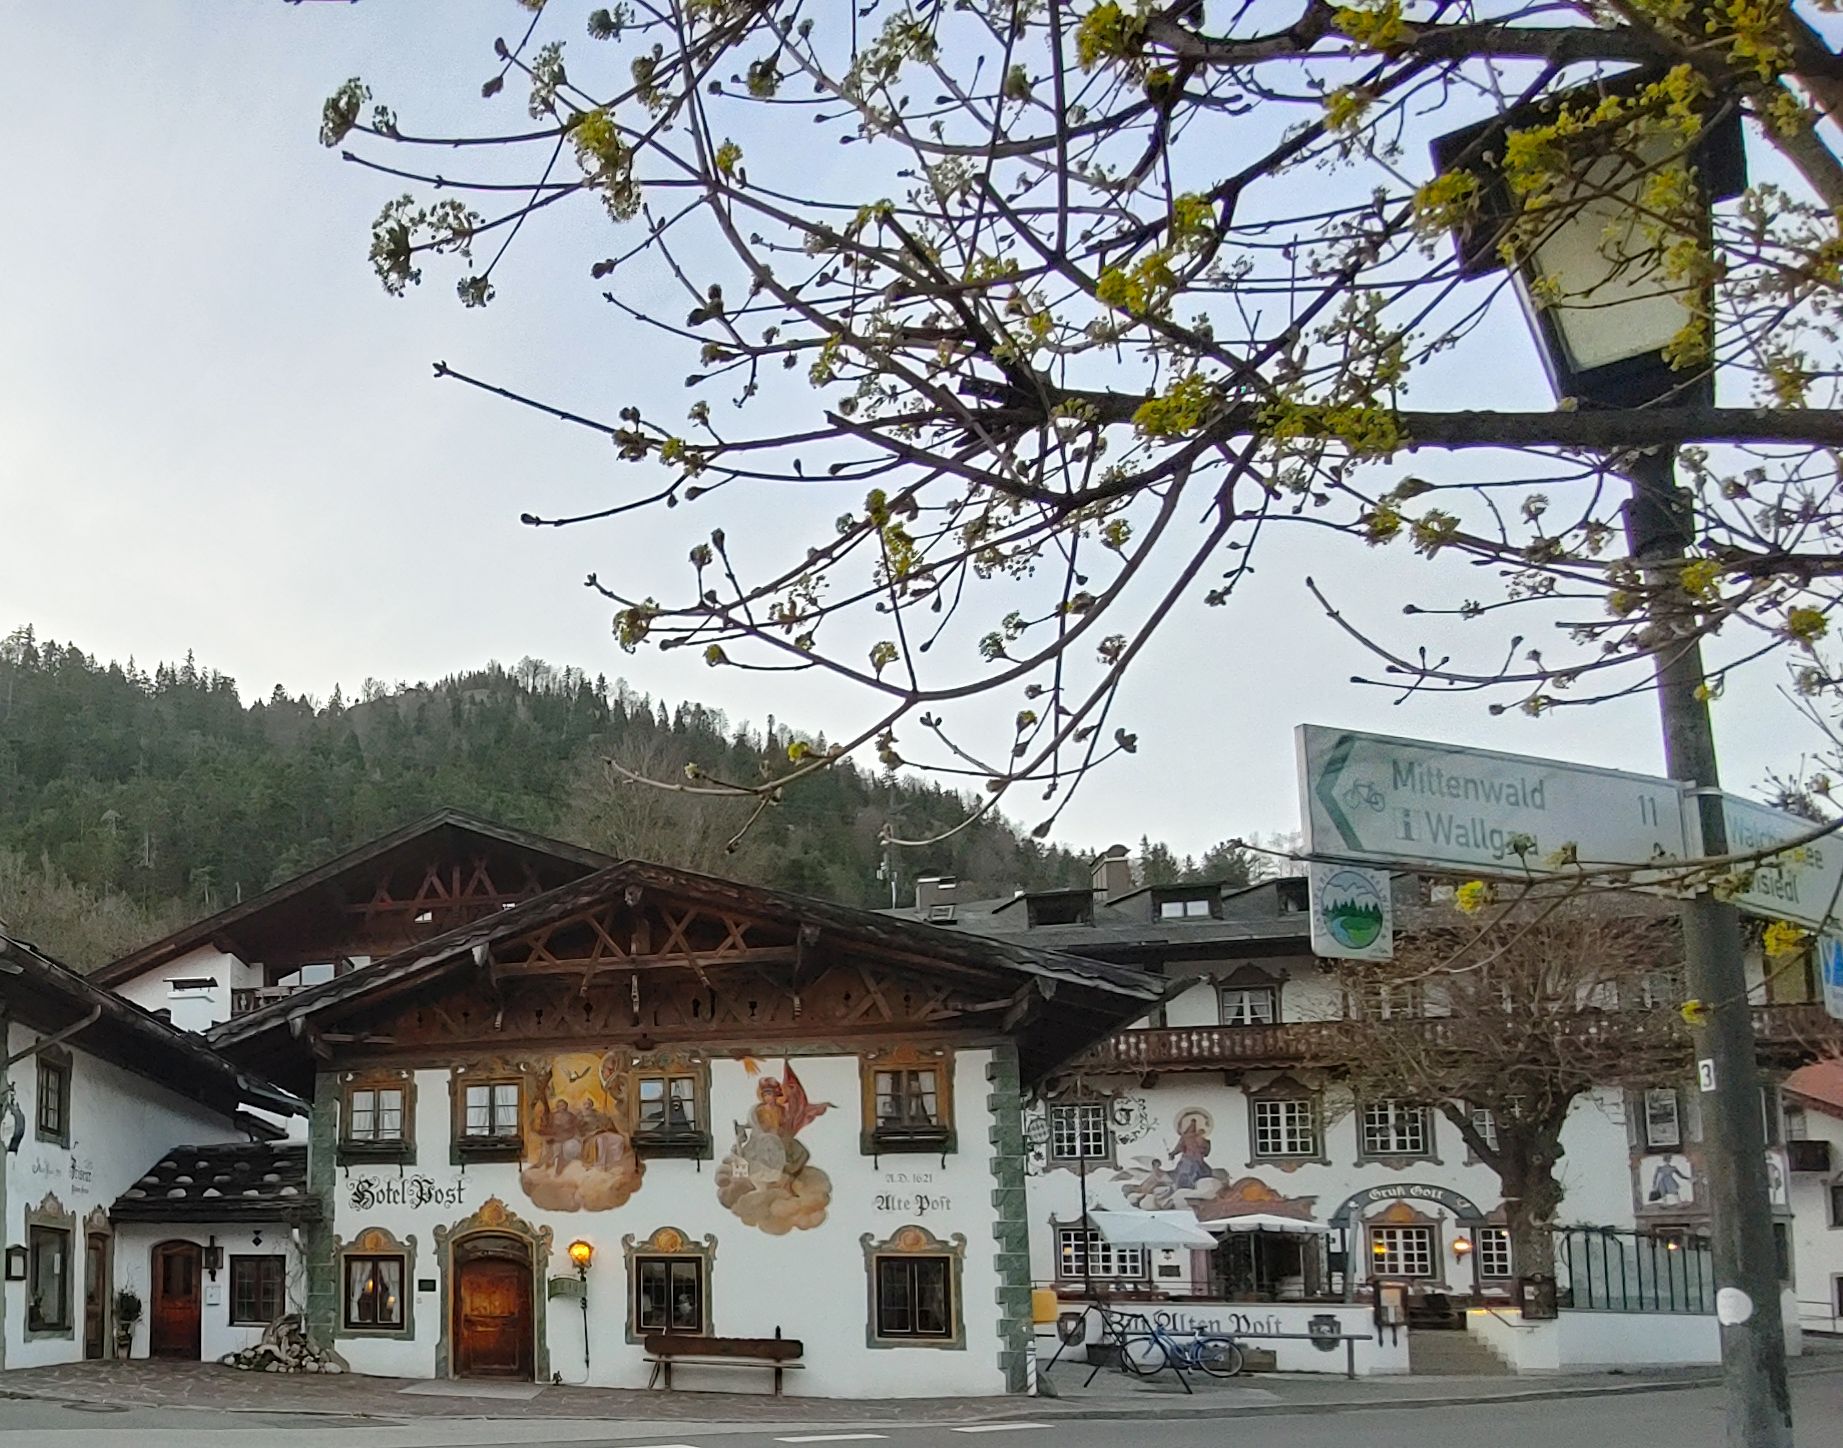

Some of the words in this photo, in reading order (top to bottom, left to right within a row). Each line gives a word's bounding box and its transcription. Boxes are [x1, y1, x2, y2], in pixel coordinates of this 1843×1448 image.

[1392, 758, 1546, 811] Mittenwald
[1638, 795, 1658, 827] 11
[1425, 811, 1539, 861] Wallgu
[1701, 1064, 1712, 1088] 3
[347, 1176, 407, 1212] Hotel
[407, 1174, 467, 1210] Post
[1409, 1185, 1444, 1200] Gott
[874, 1194, 911, 1211] Alte
[914, 1194, 952, 1217] Post
[1153, 1310, 1221, 1332] Alten
[1228, 1312, 1283, 1334] Post
